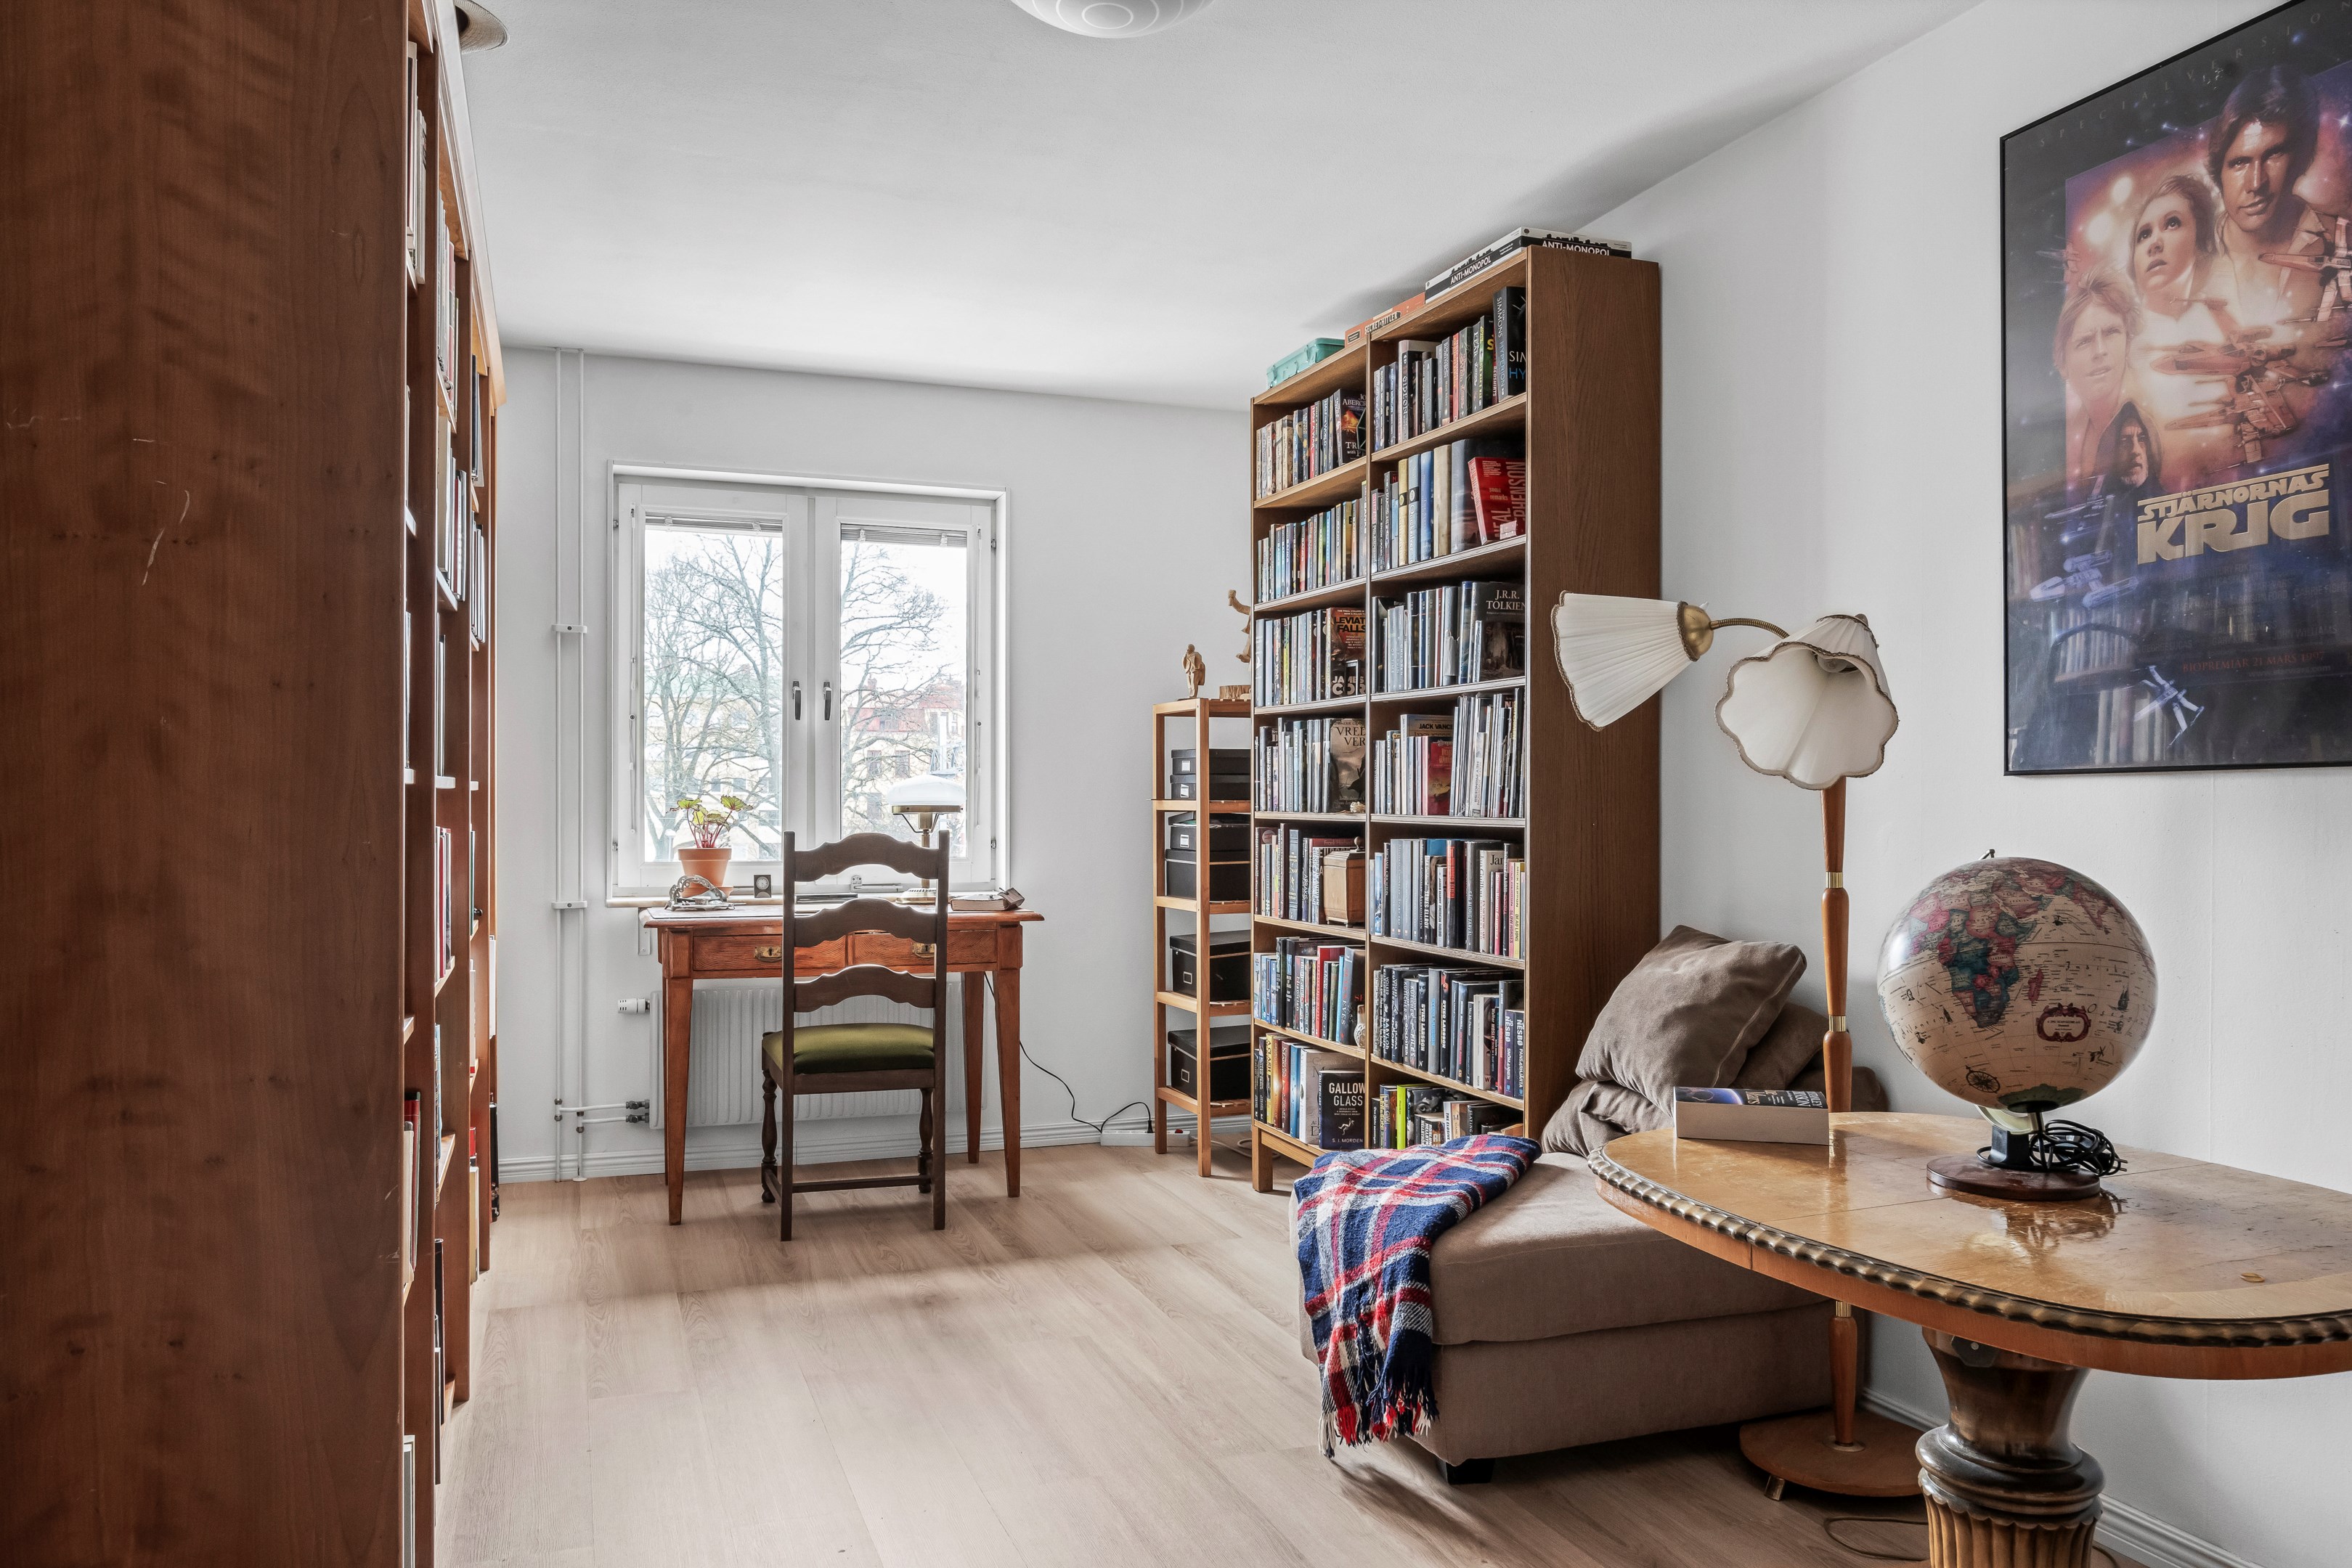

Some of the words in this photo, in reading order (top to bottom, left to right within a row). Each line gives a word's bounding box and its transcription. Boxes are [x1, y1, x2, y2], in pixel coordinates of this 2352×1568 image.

[1451, 256, 1492, 285] ANTI-MONOPOL
[2138, 470, 2329, 522] STJÄRNORNAS
[2138, 489, 2329, 565] KRIG
[1495, 589, 1520, 600] J.R.R.
[1486, 600, 1526, 611] TOLKIEN
[1337, 624, 1366, 633] FALLS
[2253, 657, 2263, 666] 21
[2266, 654, 2297, 665] MARS
[1329, 1082, 1365, 1094] GALLOW
[1333, 1095, 1363, 1106] GLASS
